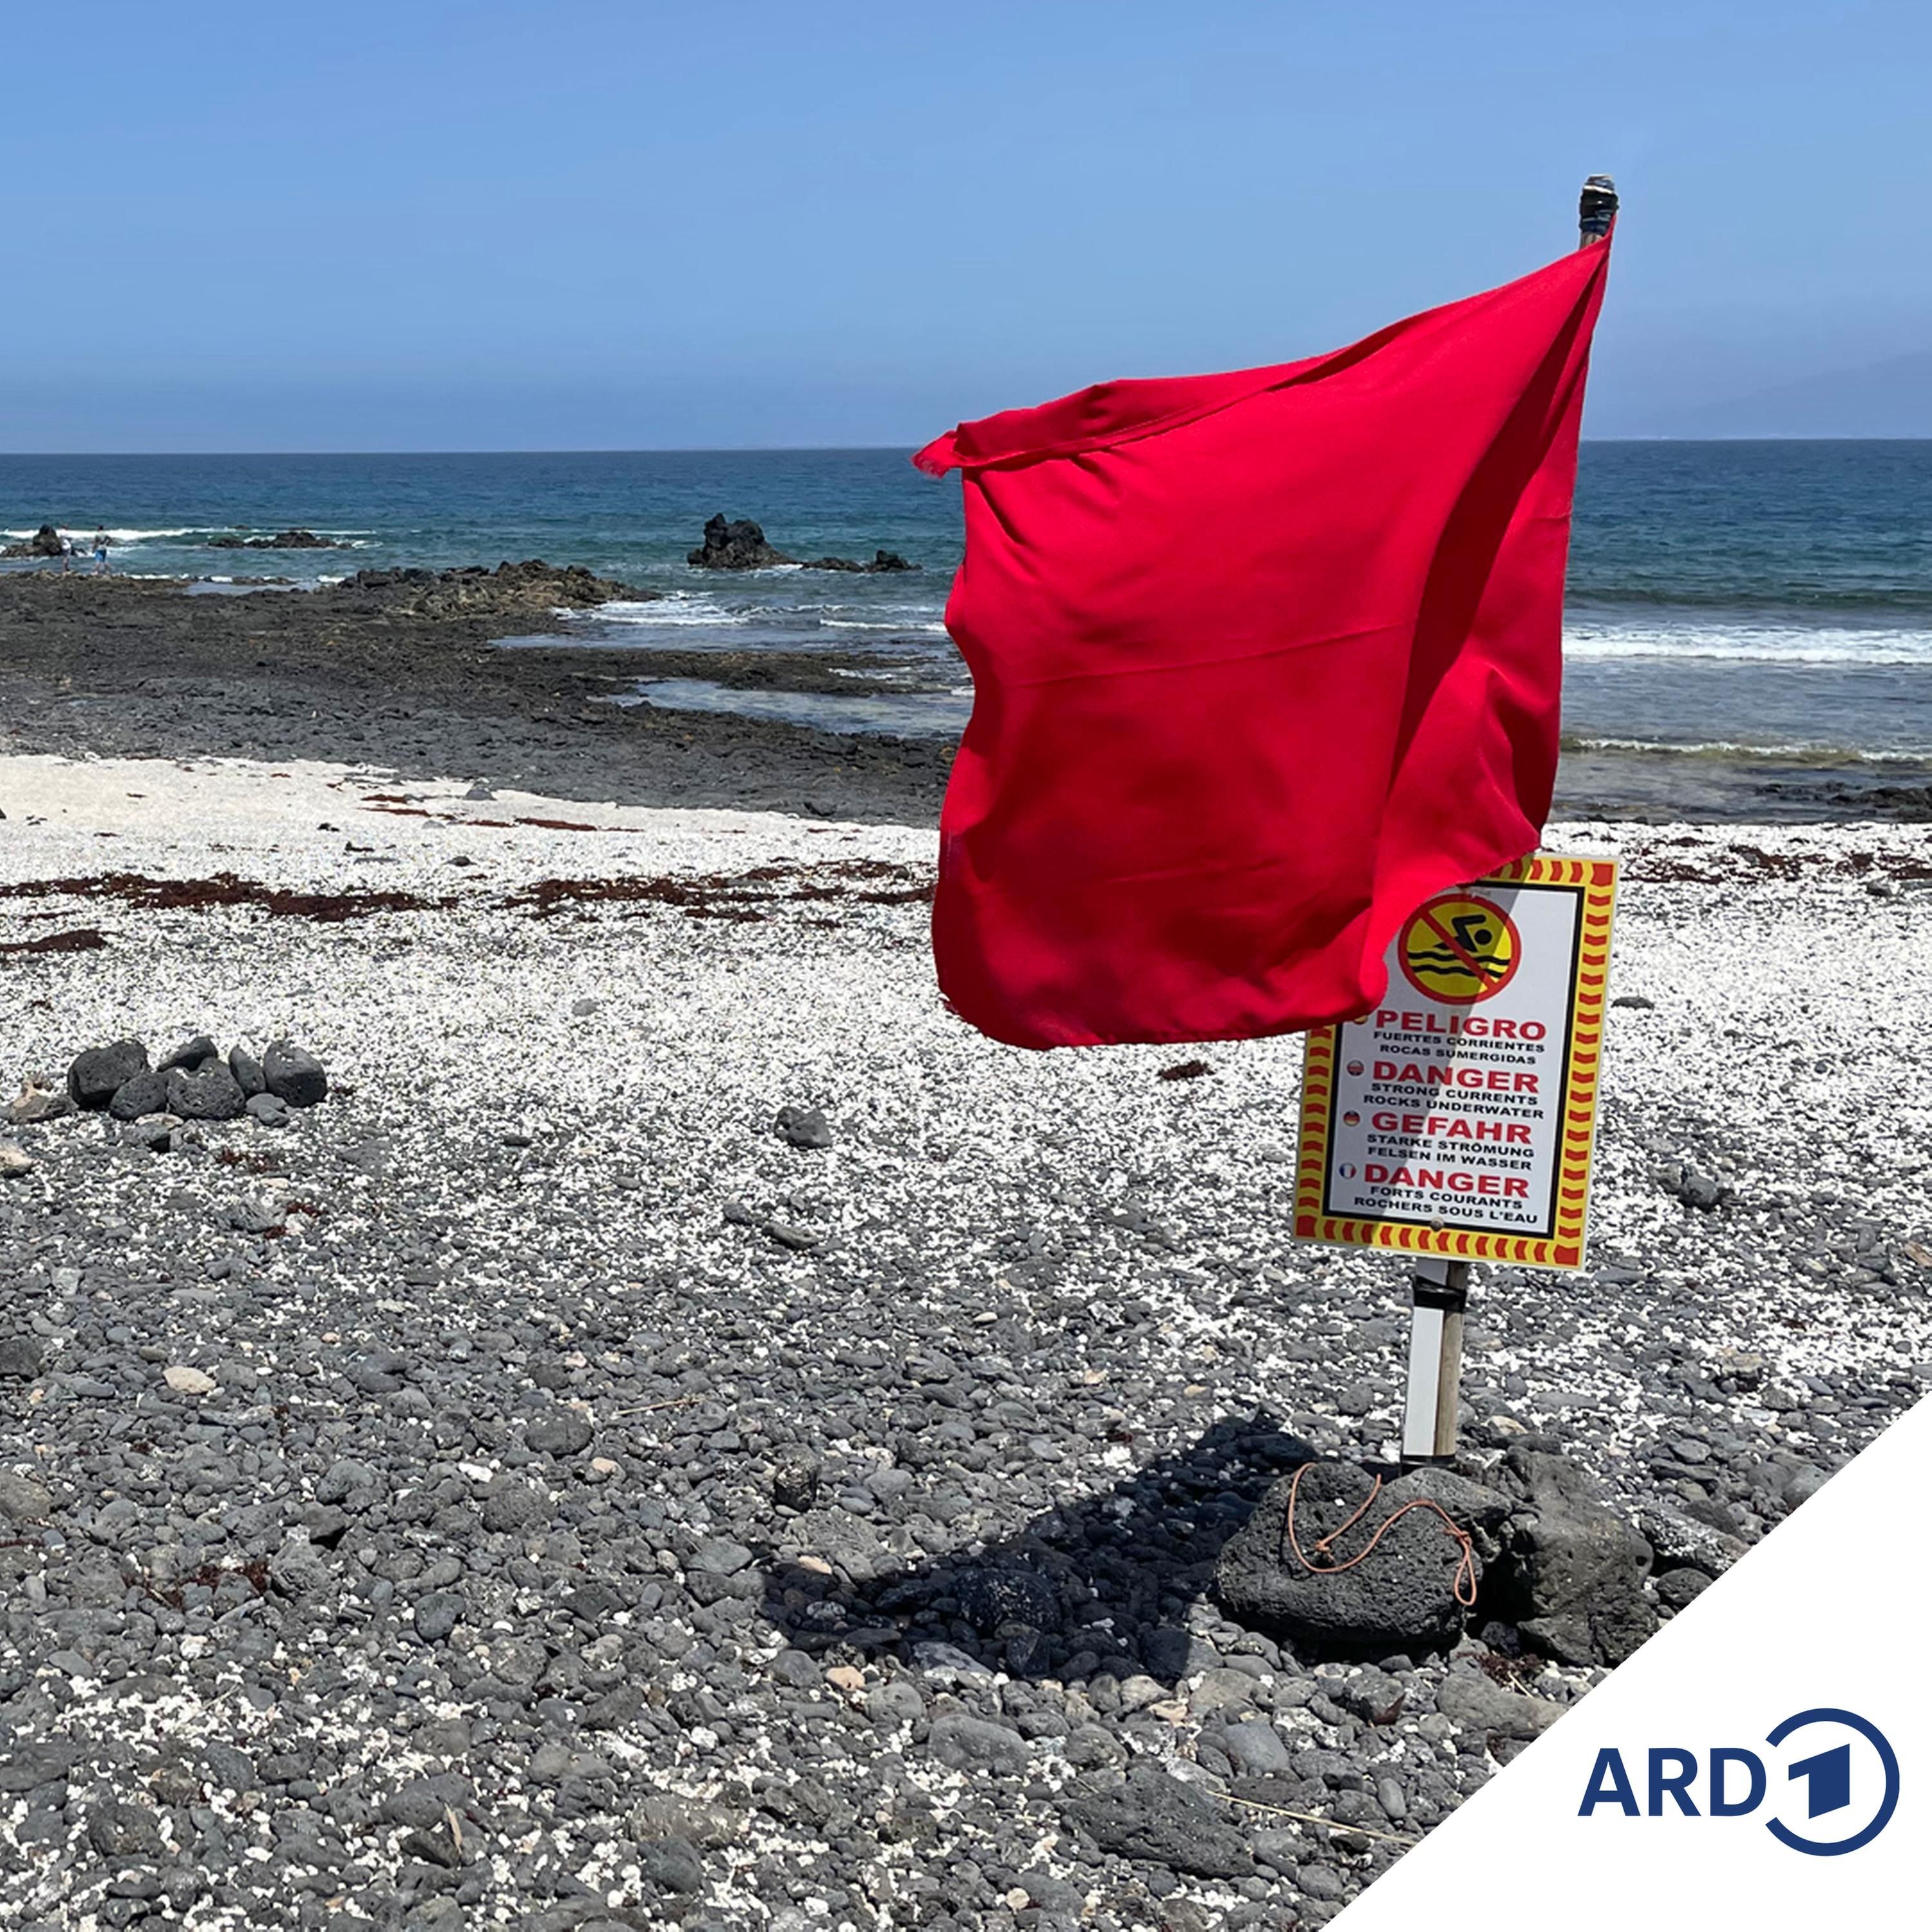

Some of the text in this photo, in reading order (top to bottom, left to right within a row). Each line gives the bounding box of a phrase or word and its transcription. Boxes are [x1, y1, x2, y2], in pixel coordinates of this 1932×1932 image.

[1376, 1010, 1546, 1040] PELIGRO
[1374, 1032, 1545, 1052] FUERTES CORRIENTES
[1380, 1045, 1537, 1065] ROCAS SUMERGIDAS
[1373, 1061, 1540, 1094] DANGER
[1371, 1083, 1538, 1106] STRONG CURRENTS
[1363, 1095, 1544, 1119] ROCKS UNDERWATER
[1372, 1112, 1532, 1144] GEFAHR
[1367, 1134, 1534, 1158] STARKE STRÖMUNG
[1368, 1147, 1532, 1170] FELSEN IM WASSER
[1364, 1164, 1530, 1198] DANGER
[1370, 1186, 1522, 1209] FORTS COURANTS
[1354, 1197, 1538, 1224] ROCHERS SOUS L'EAU
